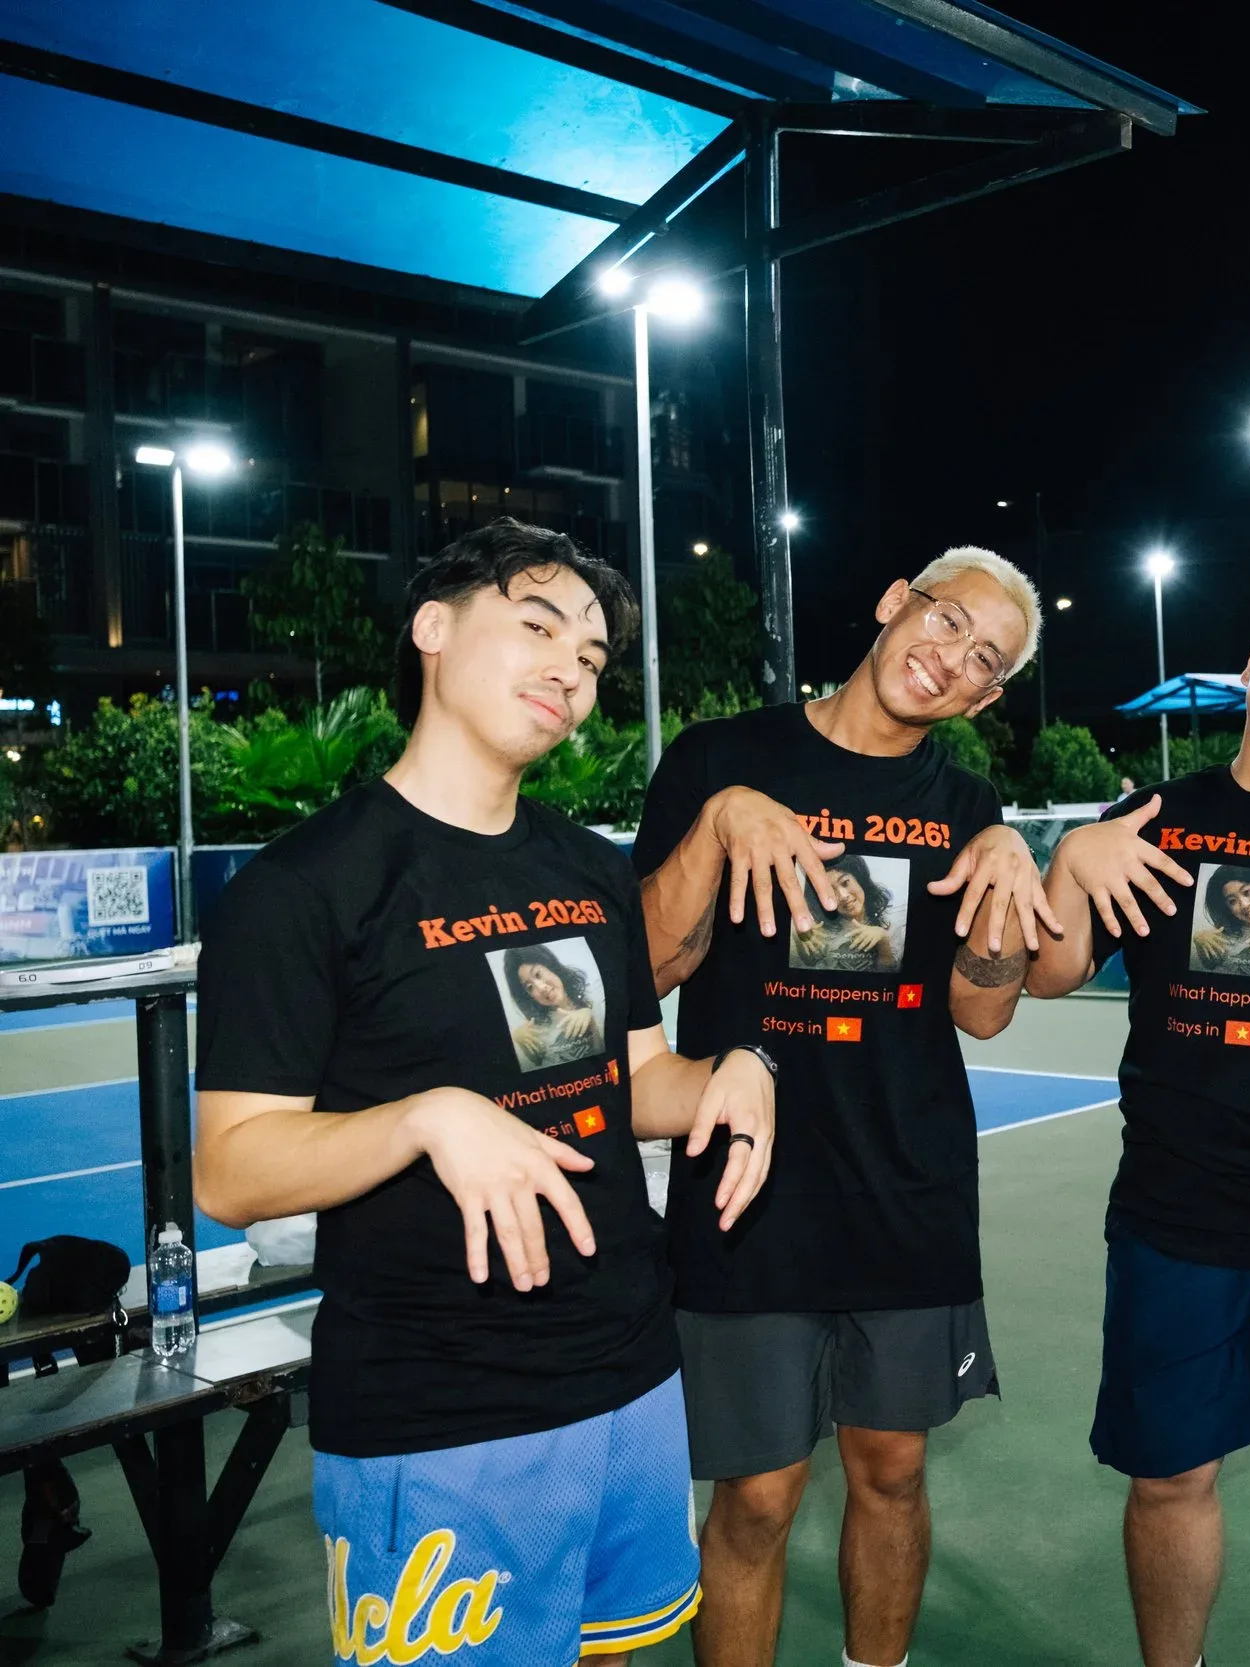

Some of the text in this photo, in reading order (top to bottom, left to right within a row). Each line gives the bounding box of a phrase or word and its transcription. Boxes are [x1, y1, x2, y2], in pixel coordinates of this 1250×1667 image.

[796, 808, 950, 849] vin 2026!
[418, 899, 609, 950] Kevin 2026!
[18, 973, 37, 983] 6.0
[764, 981, 895, 1004] What happens in
[1169, 981, 1206, 1000] What
[762, 1016, 823, 1036] Stays in
[1167, 1016, 1220, 1038] Stays in
[494, 1085, 548, 1110] What
[546, 1073, 603, 1099] happens
[559, 1120, 575, 1136] in
